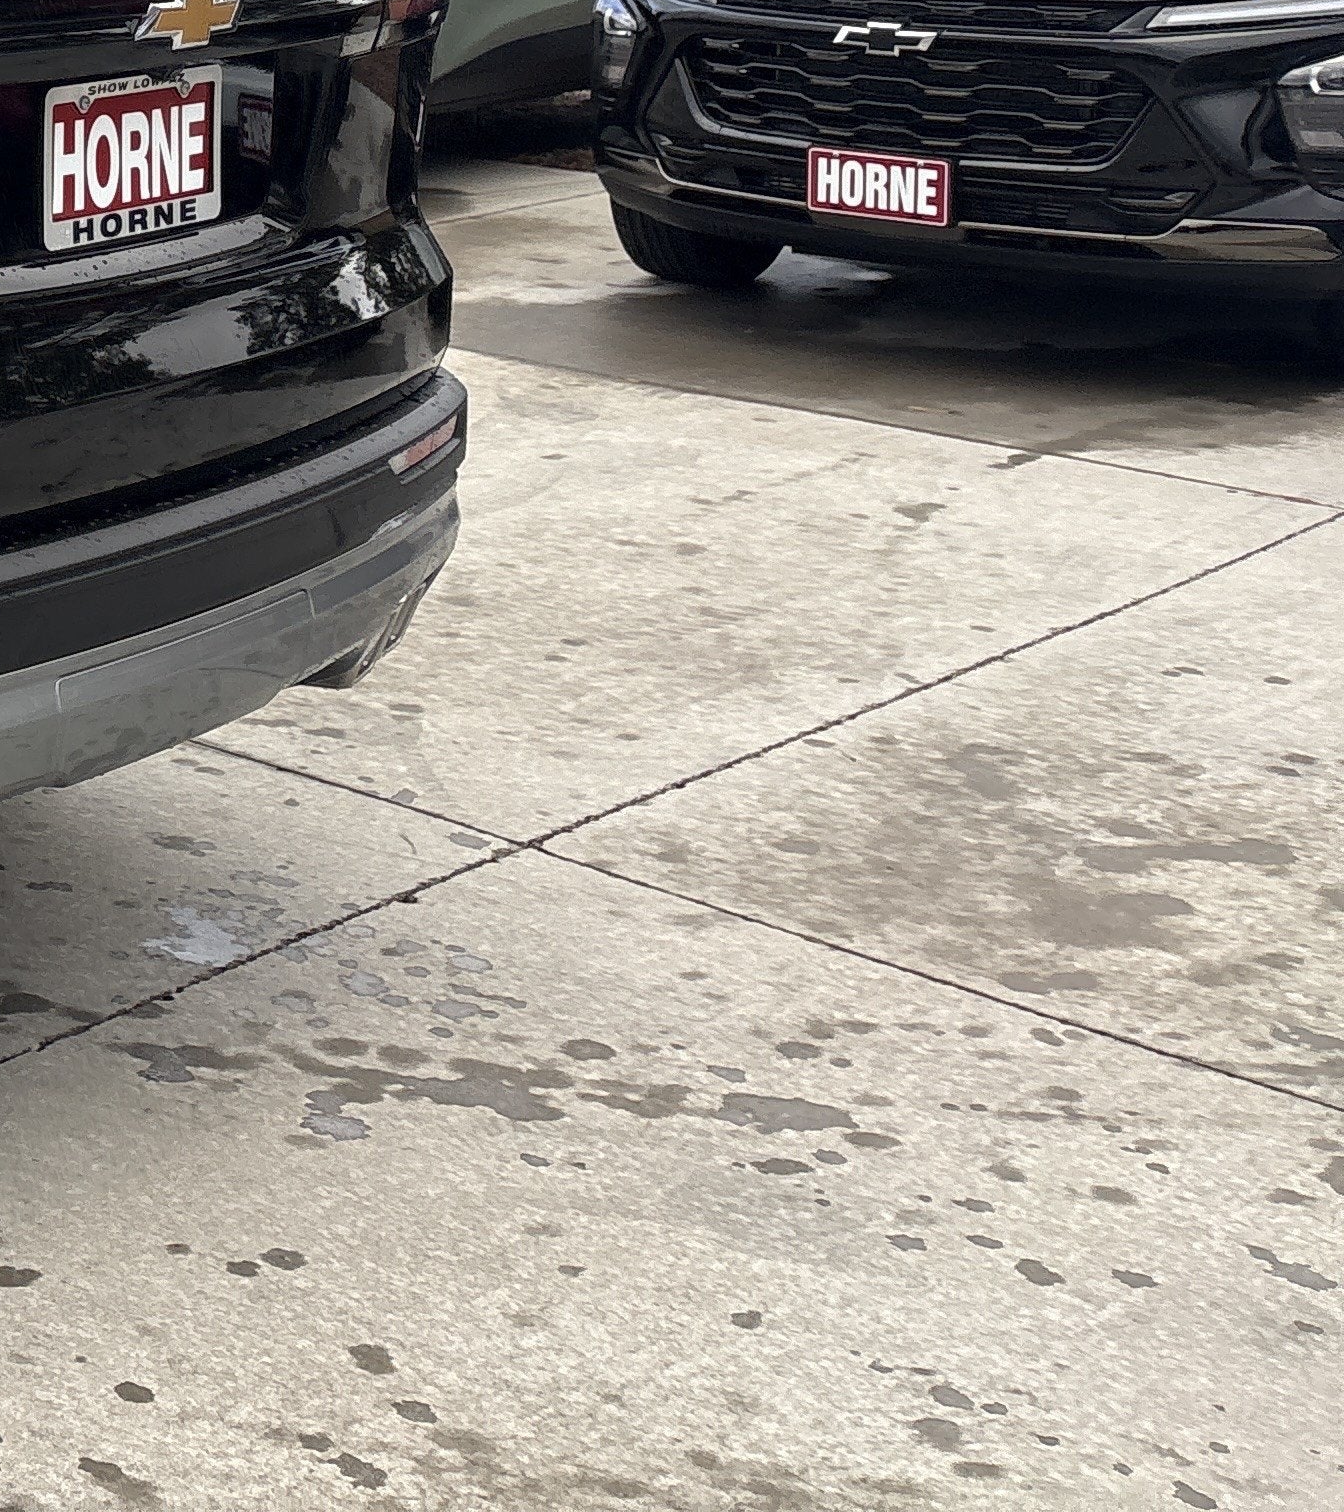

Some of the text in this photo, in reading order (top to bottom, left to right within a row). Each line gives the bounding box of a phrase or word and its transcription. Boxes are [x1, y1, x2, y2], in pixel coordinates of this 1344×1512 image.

[88, 81, 129, 96] SHOW
[52, 101, 206, 215] HORNE
[816, 156, 938, 217] HORNE
[72, 198, 197, 244] HORNE
